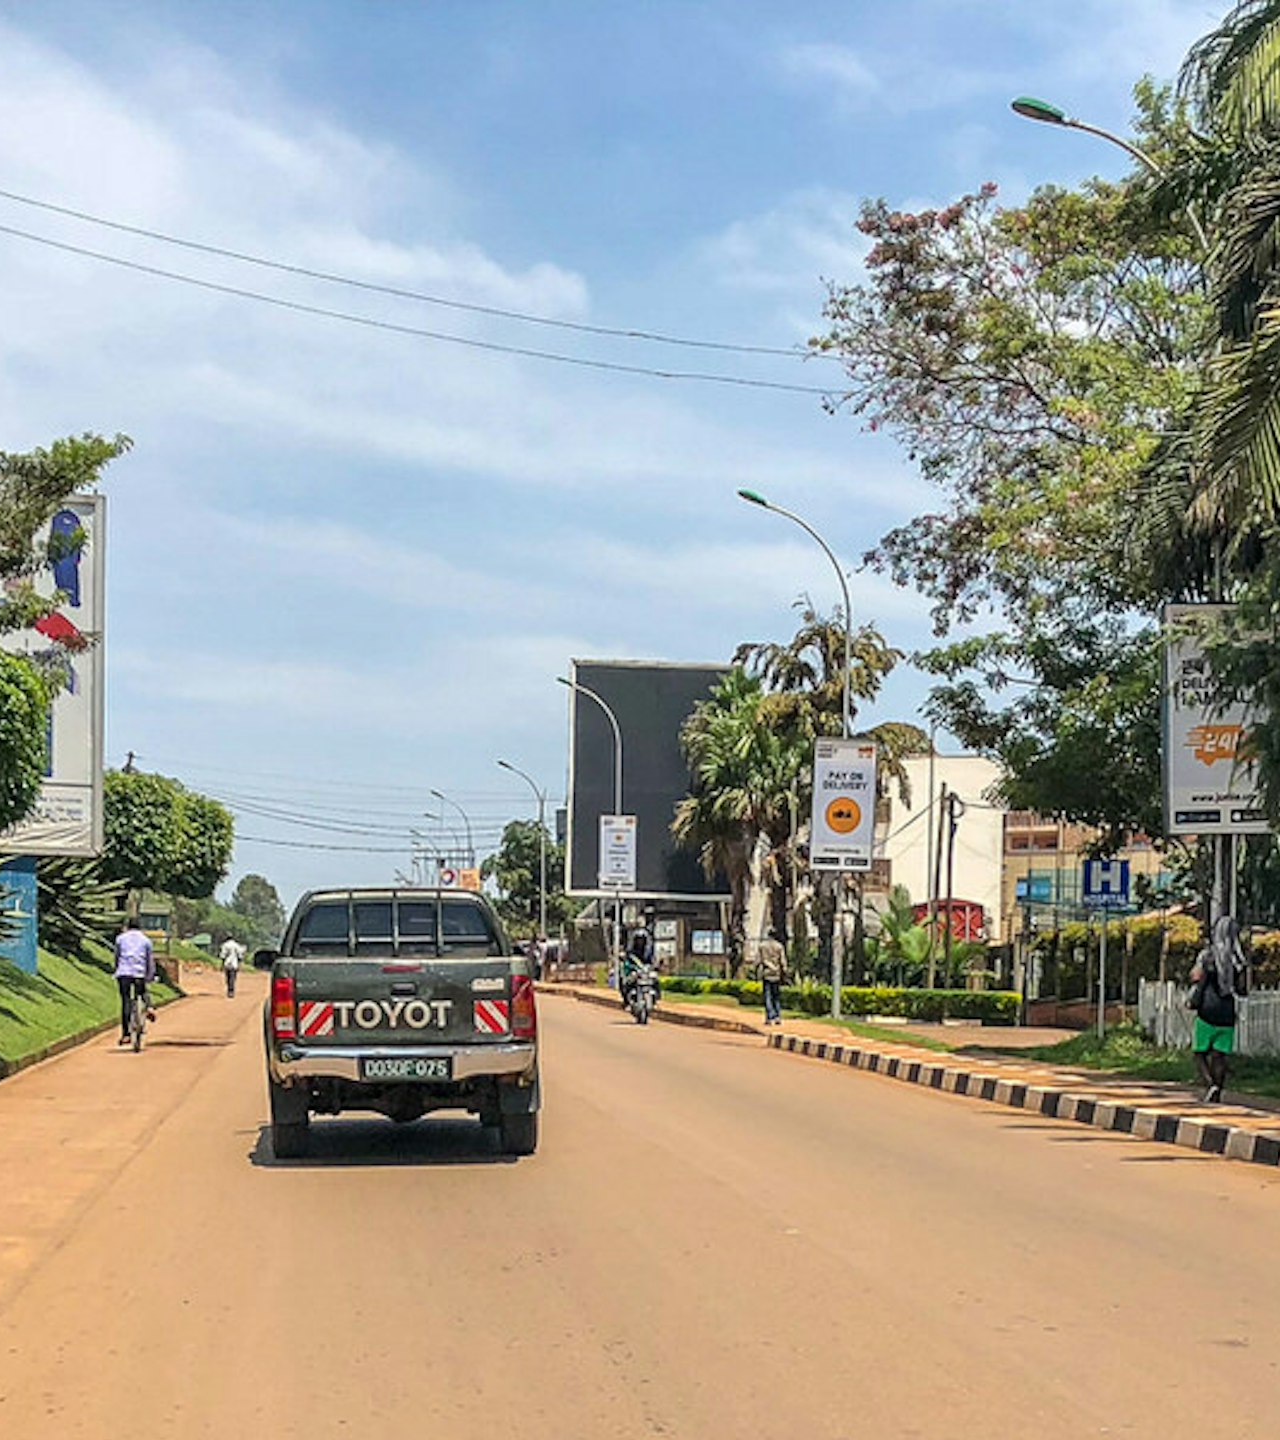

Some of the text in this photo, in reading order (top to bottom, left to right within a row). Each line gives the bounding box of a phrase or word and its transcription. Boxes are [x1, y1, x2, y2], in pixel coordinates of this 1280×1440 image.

[823, 781, 868, 791] DELIVERY
[829, 771, 863, 781] PAY ON
[1090, 860, 1121, 892] H
[332, 999, 452, 1029] TOYOT
